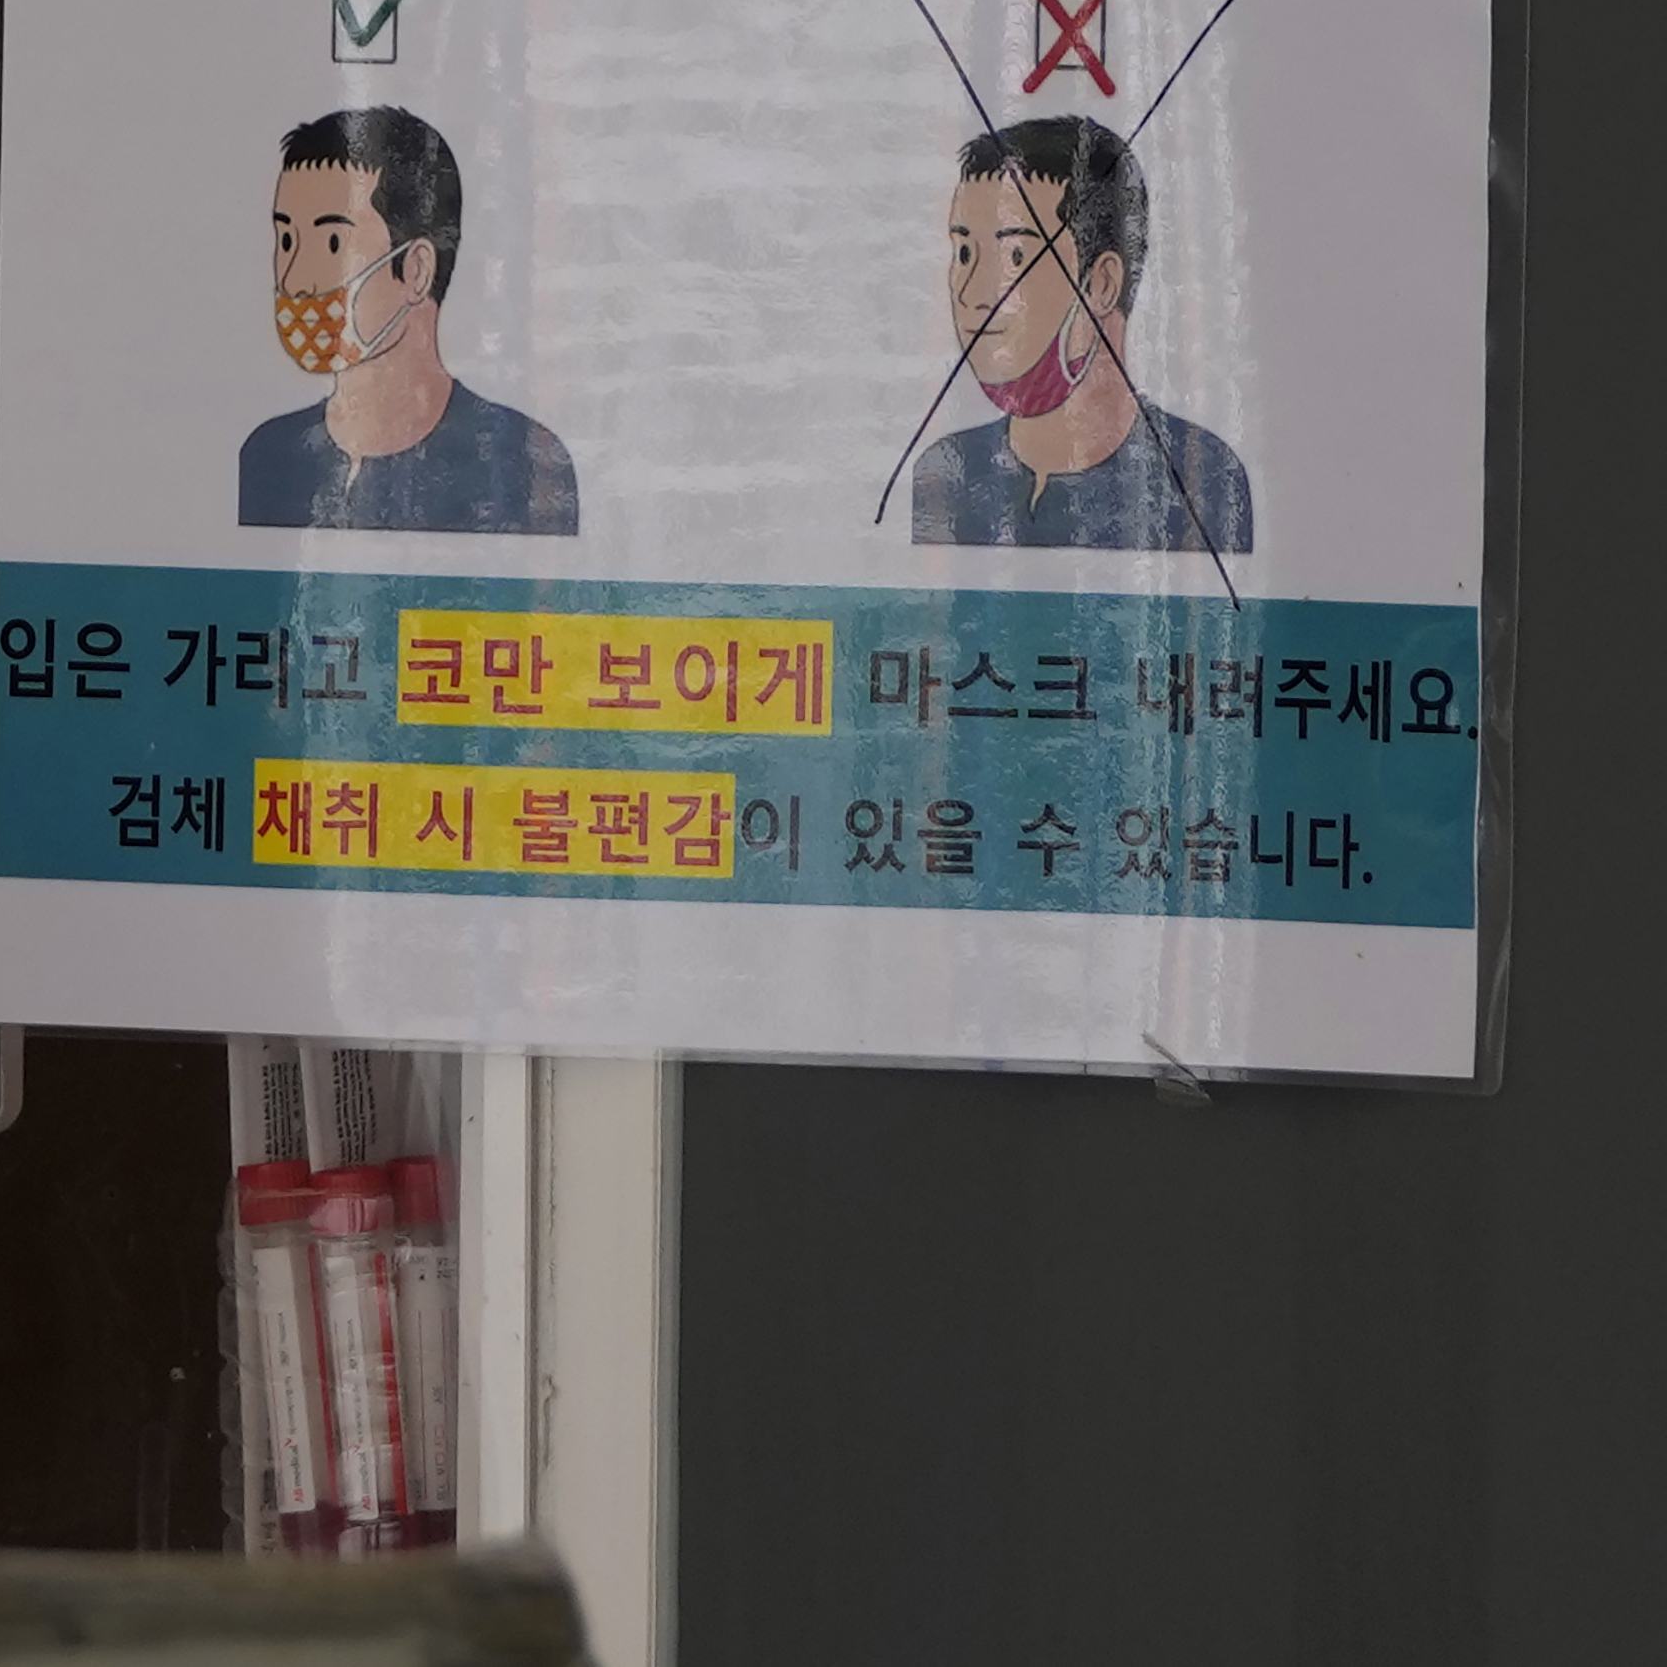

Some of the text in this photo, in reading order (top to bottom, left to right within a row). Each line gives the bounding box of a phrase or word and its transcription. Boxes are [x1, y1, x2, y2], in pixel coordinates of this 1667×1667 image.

[0, 617, 1478, 742] 입은 가리고 코만 보이게 마스크 내려주세요.
[108, 774, 1375, 888] 검체 채취 시 불편감이 있을 수 있습니다.
